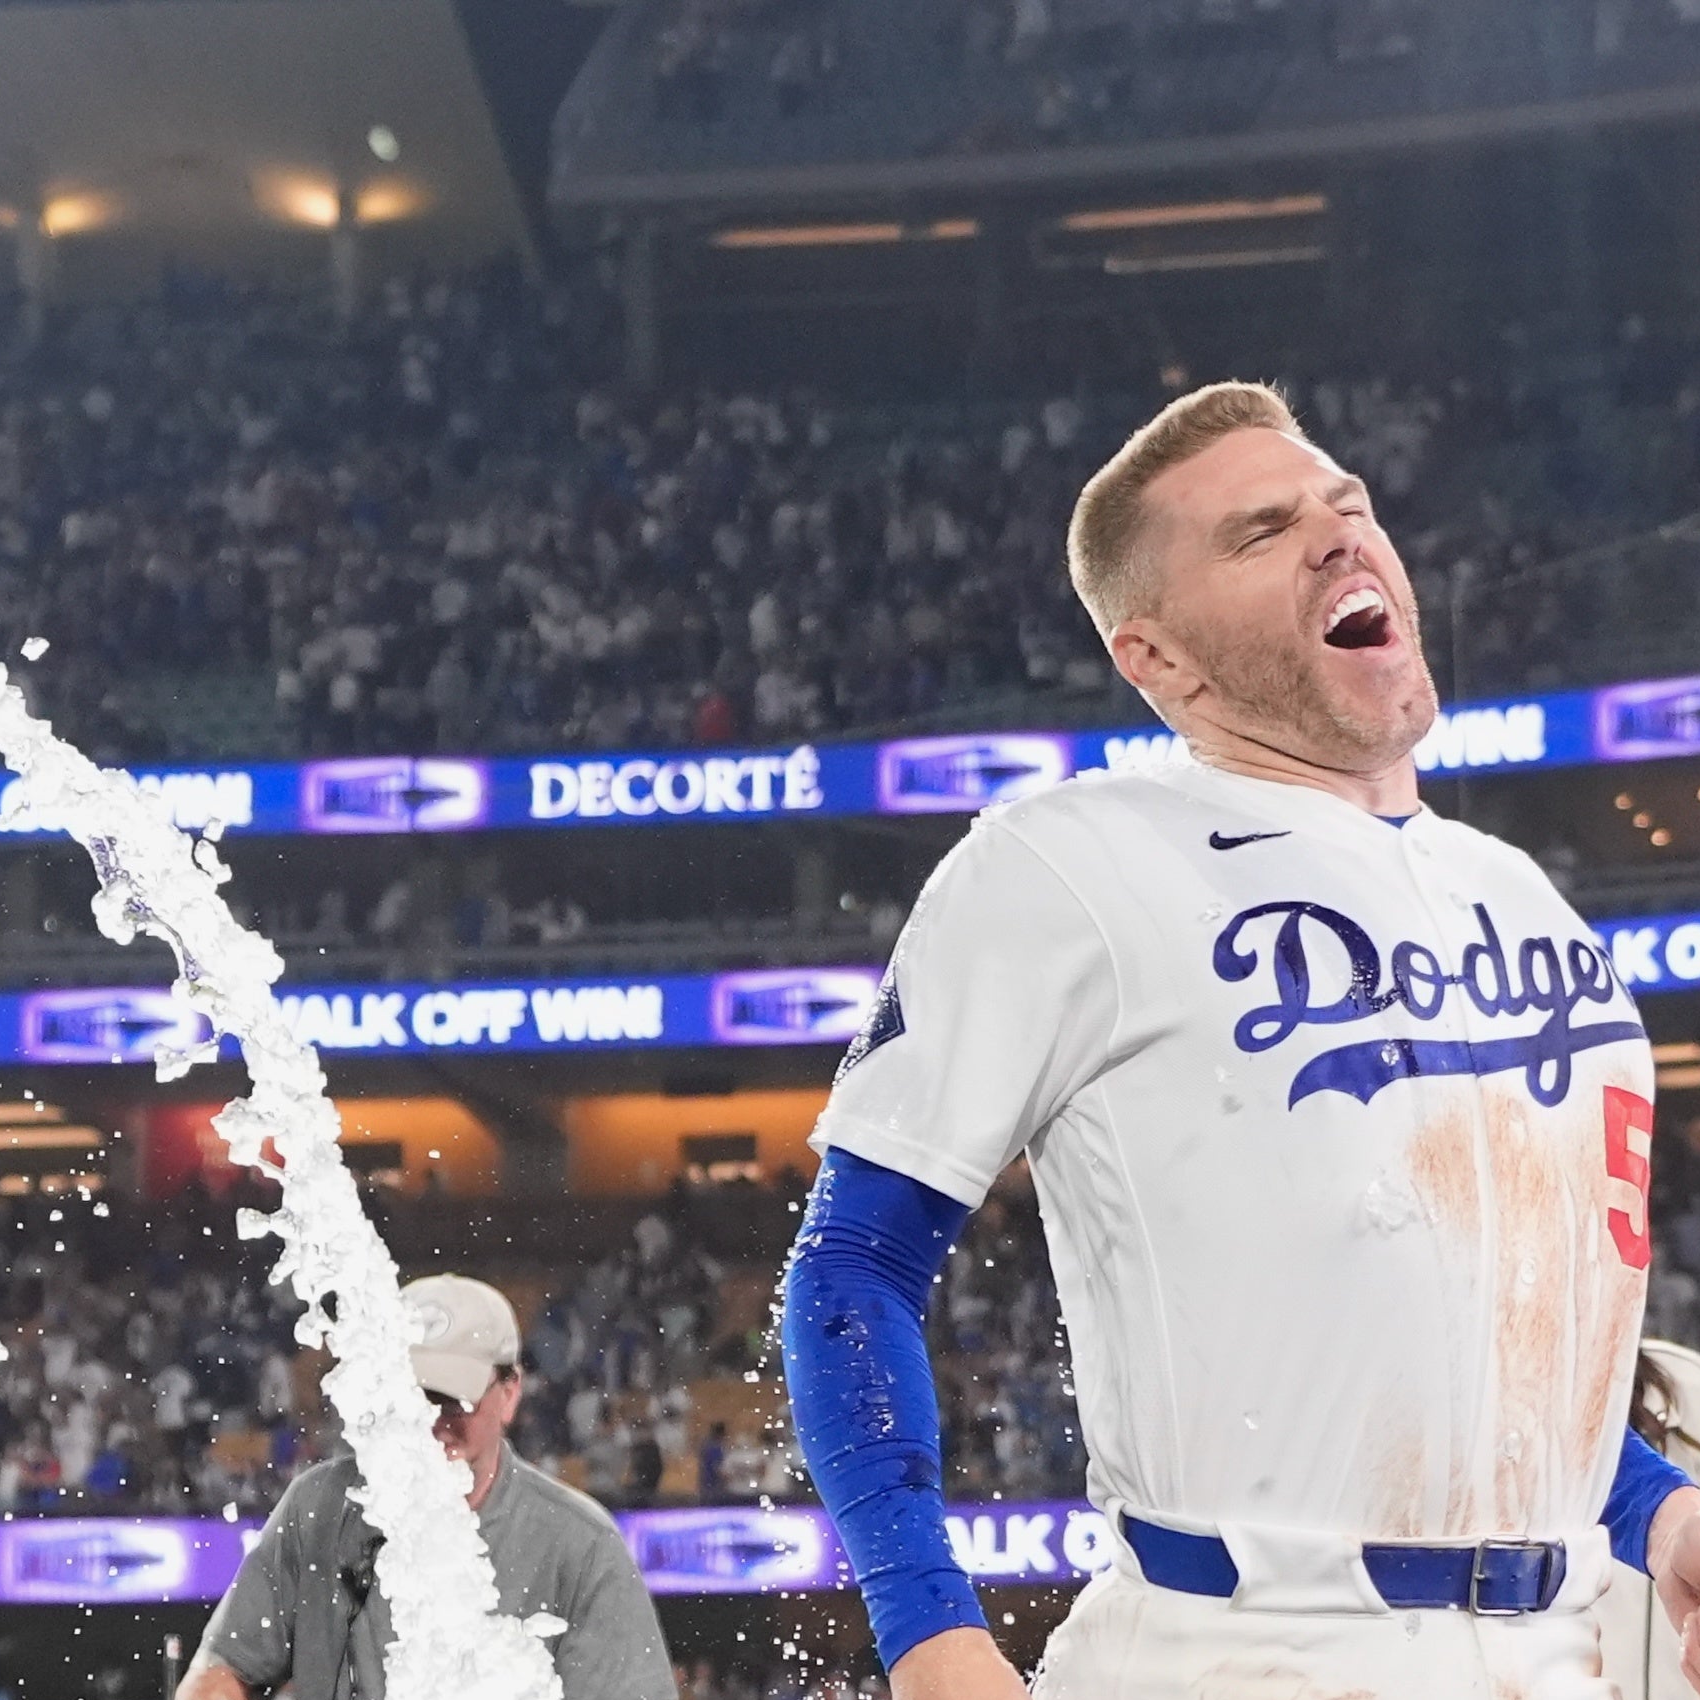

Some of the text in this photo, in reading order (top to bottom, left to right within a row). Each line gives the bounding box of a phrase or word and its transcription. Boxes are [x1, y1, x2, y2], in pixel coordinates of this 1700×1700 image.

[529, 745, 824, 819] DECORTÉ
[411, 990, 528, 1045] OFF
[531, 985, 664, 1042] WIN!
